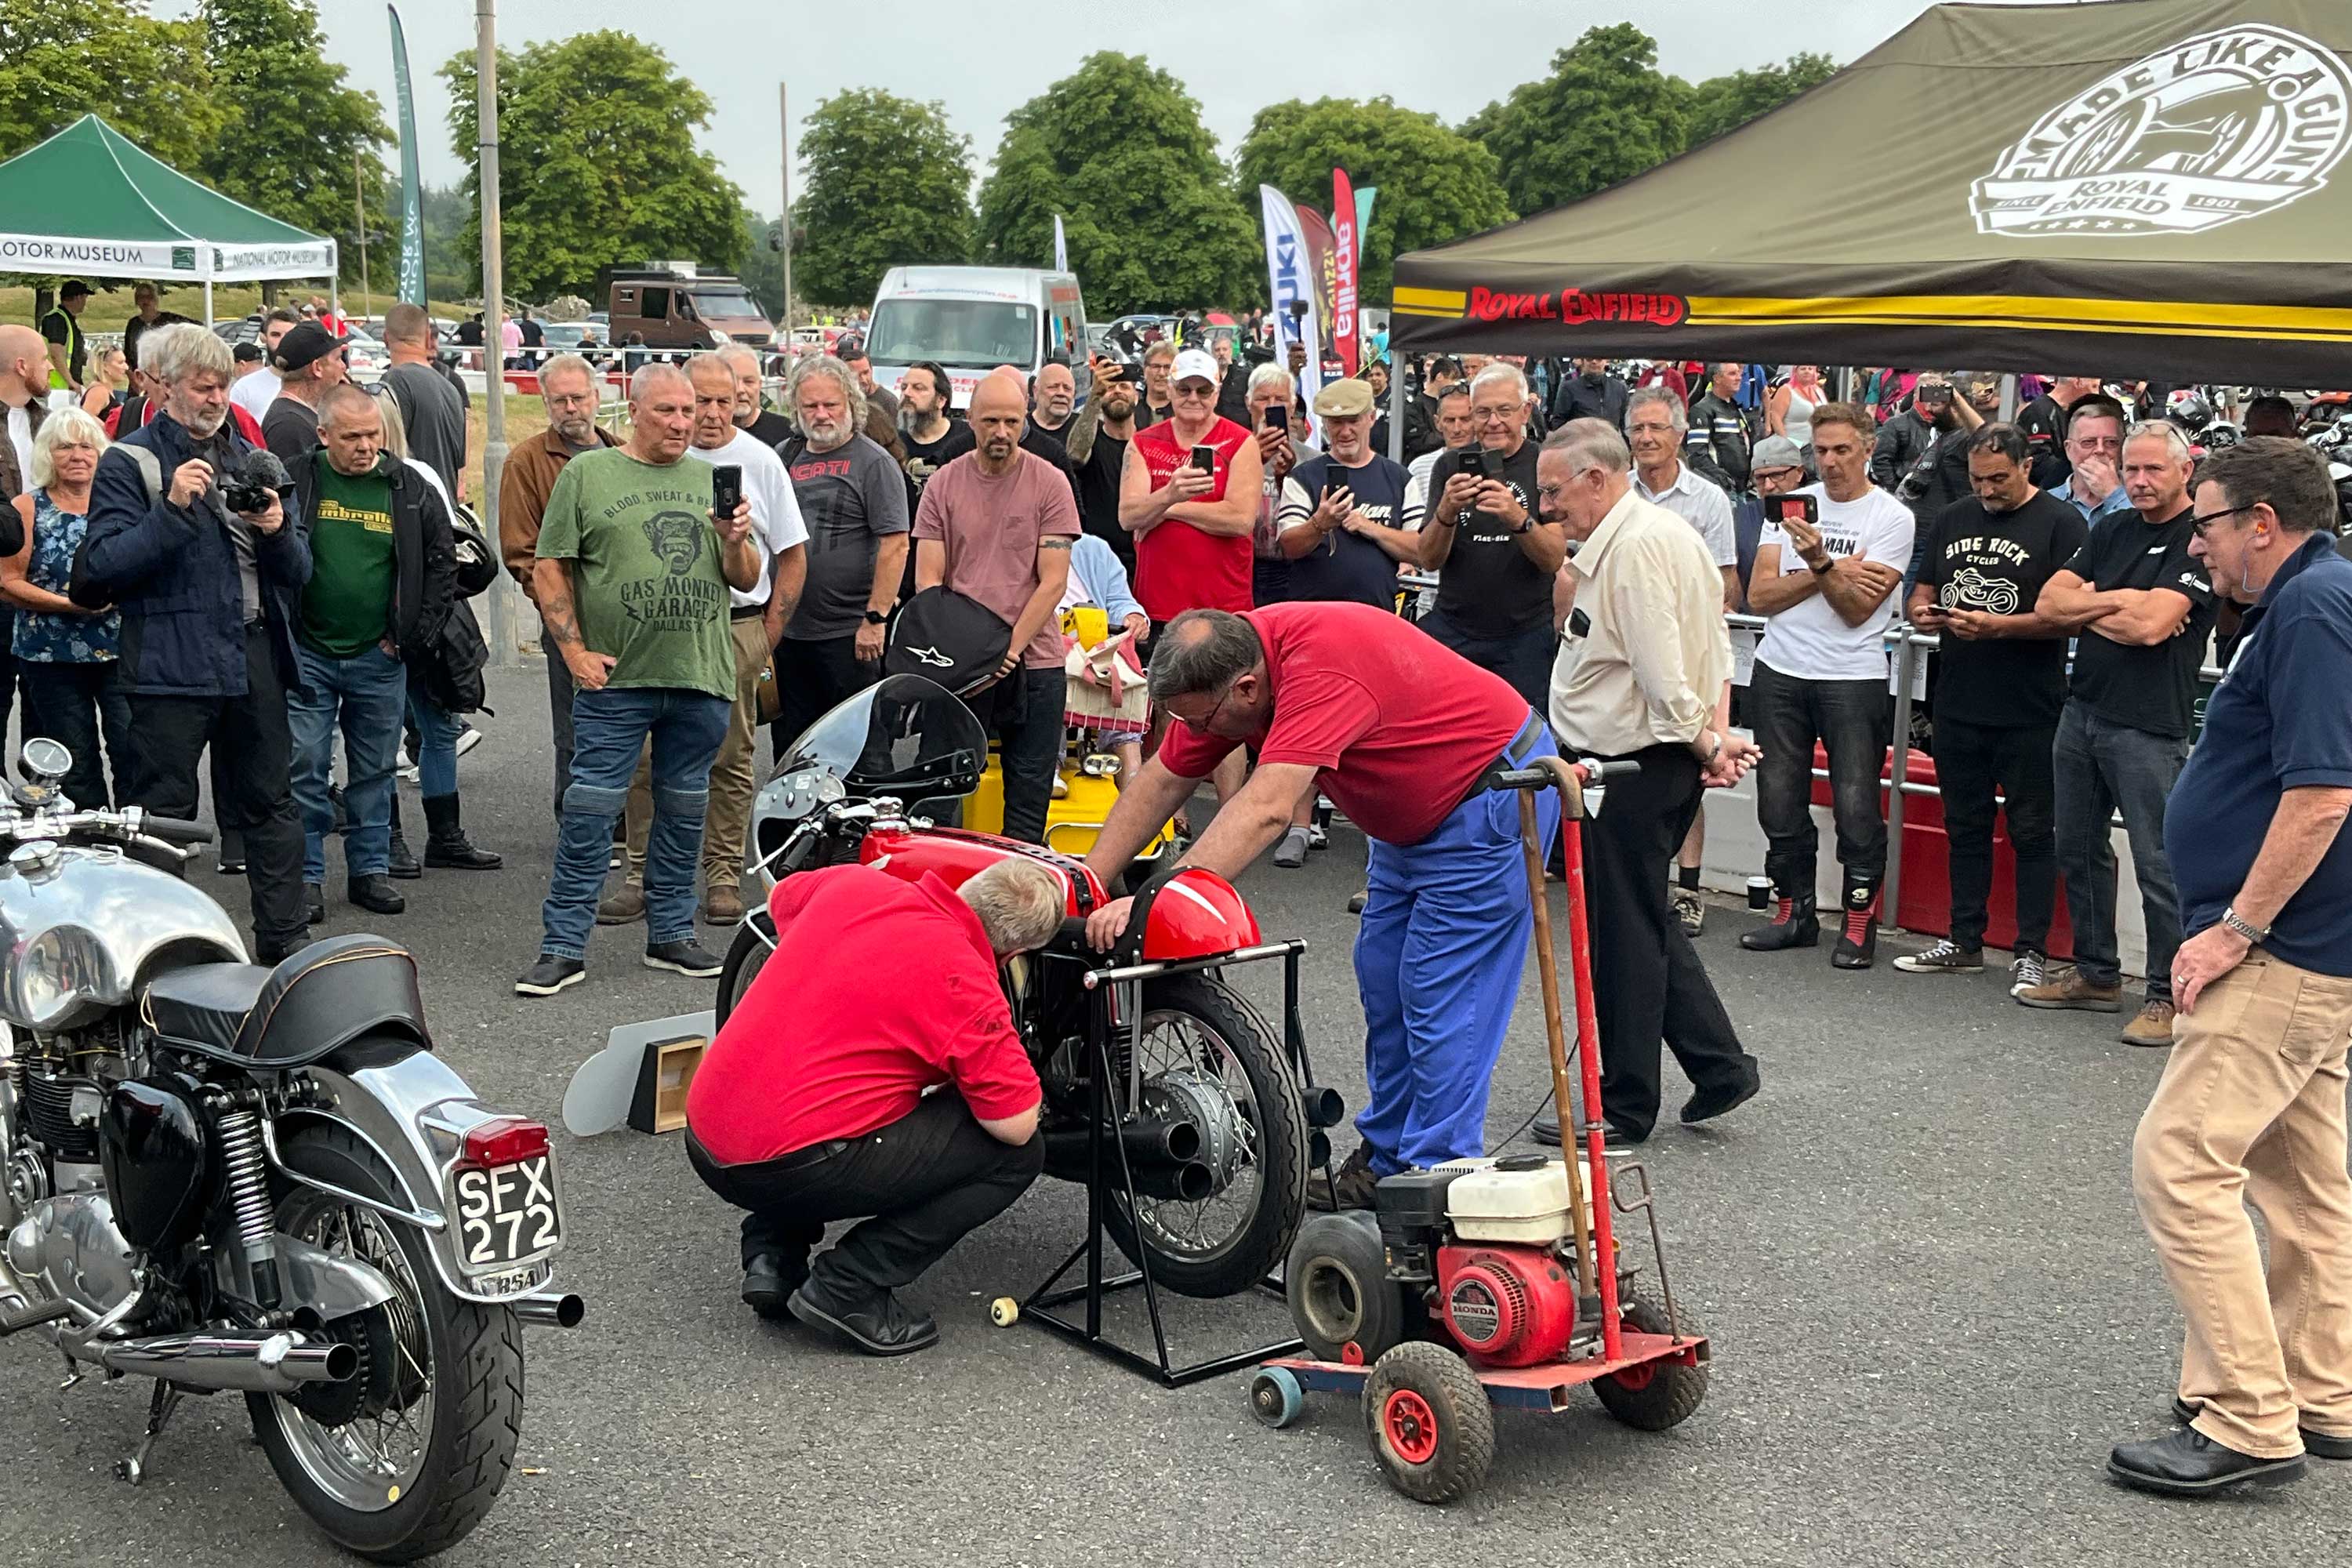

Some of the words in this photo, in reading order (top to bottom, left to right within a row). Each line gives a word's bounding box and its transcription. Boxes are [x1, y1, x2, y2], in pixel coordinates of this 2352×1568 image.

[2172, 36, 2296, 76] LIKE
[2289, 67, 2326, 95] A
[2016, 67, 2155, 164] MADE
[2284, 93, 2340, 167] GUN
[2069, 180, 2169, 198] ROYAL
[1993, 196, 2043, 208] SINCE
[2040, 196, 2170, 216] ENFIELD
[2193, 196, 2241, 209] 1901
[0, 241, 55, 260] OTOR
[60, 245, 143, 263] MUSEUM
[234, 251, 266, 267] NATIONAL
[267, 250, 291, 267] MOTOR
[292, 249, 318, 265] MUSEUM
[1335, 221, 1356, 338] aprilia
[1277, 233, 1299, 350] ZUKI
[1468, 285, 1557, 321] ROYAL
[1560, 287, 1684, 326] ENFIELD
[646, 491, 681, 503] SWEAT
[686, 492, 694, 503] &
[1946, 537, 1984, 559] SIDE
[1987, 537, 2030, 566] ROCK
[1965, 554, 1999, 565] CYCLES
[621, 579, 655, 602] GAS
[644, 597, 709, 619] GARAGE
[459, 1156, 554, 1218] SFX
[463, 1203, 558, 1264] 272
[1454, 1305, 1496, 1316] HONDA
